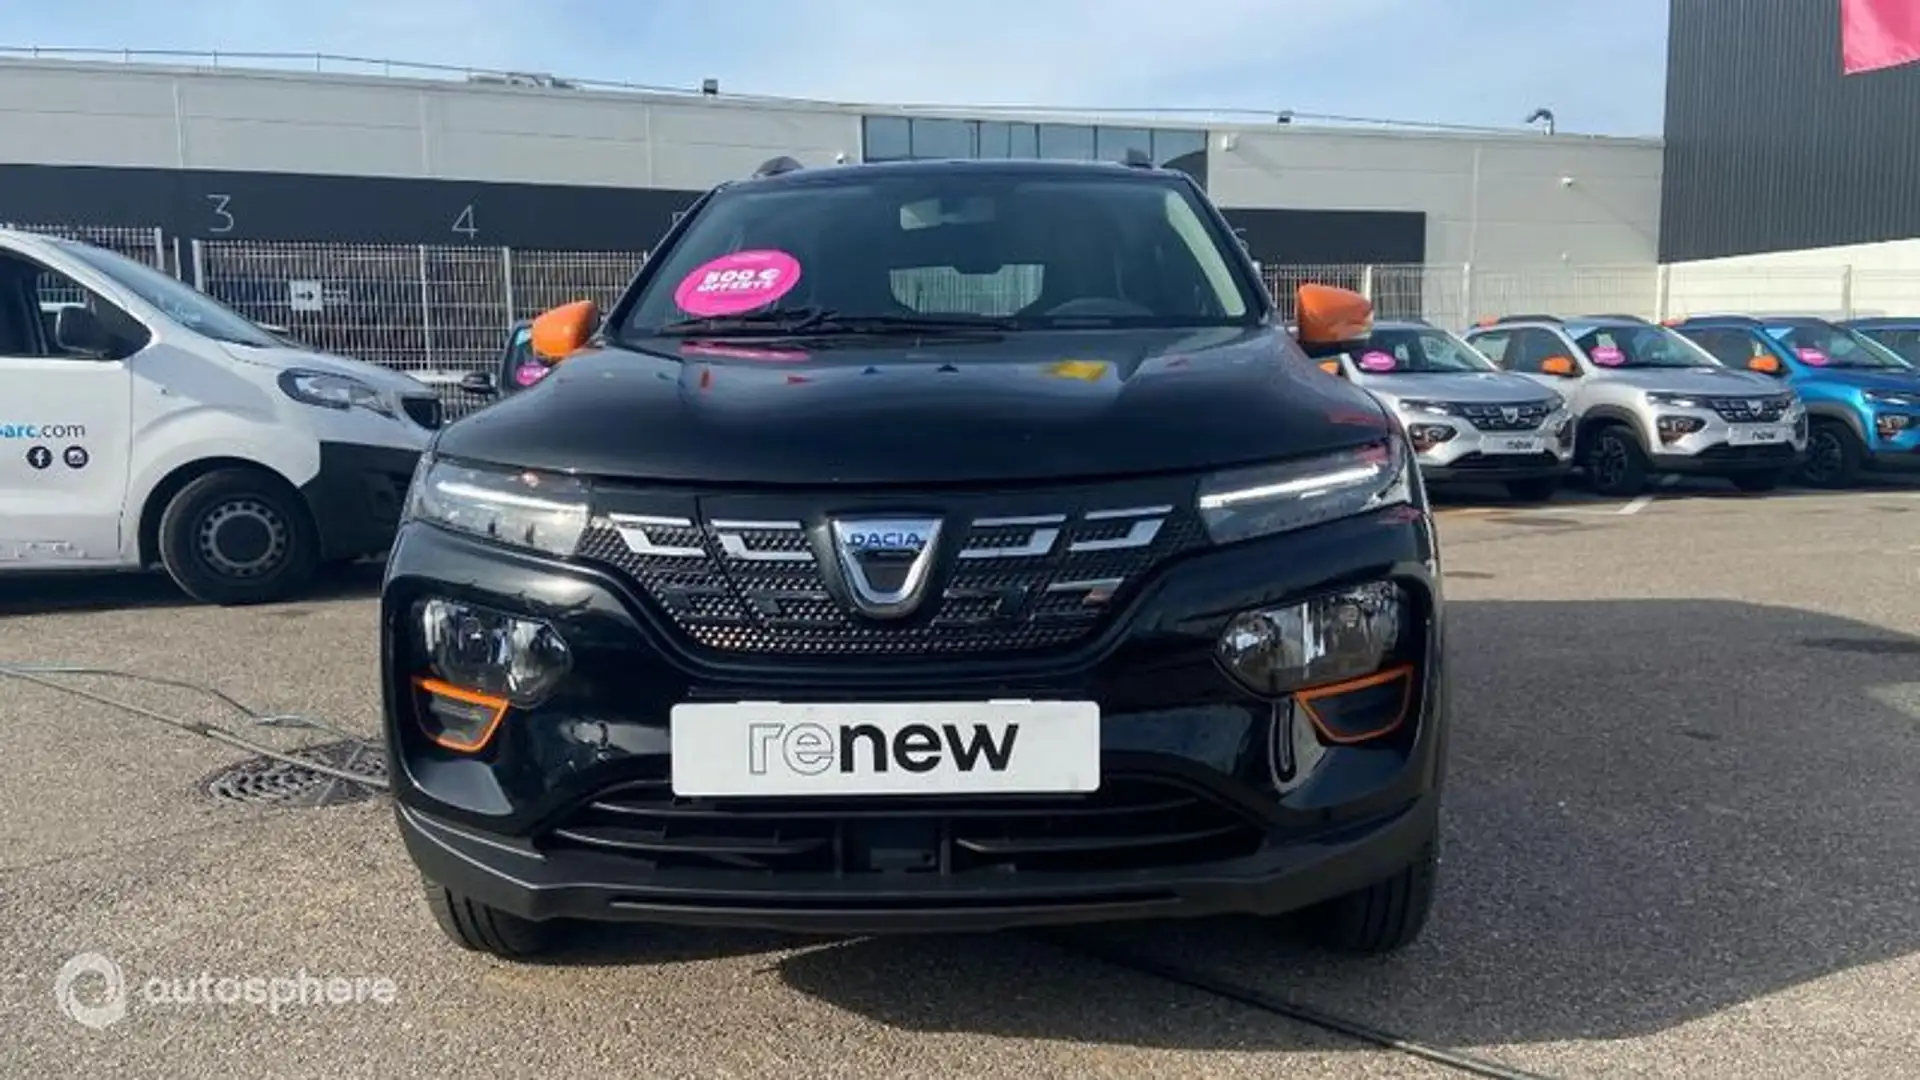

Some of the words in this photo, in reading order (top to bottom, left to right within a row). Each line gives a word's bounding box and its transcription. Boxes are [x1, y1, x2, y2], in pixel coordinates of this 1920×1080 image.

[206, 194, 235, 233] 3
[451, 204, 479, 241] 4
[0, 424, 86, 438] arc.com
[849, 532, 923, 547] DACIA
[747, 722, 1020, 777] renew
